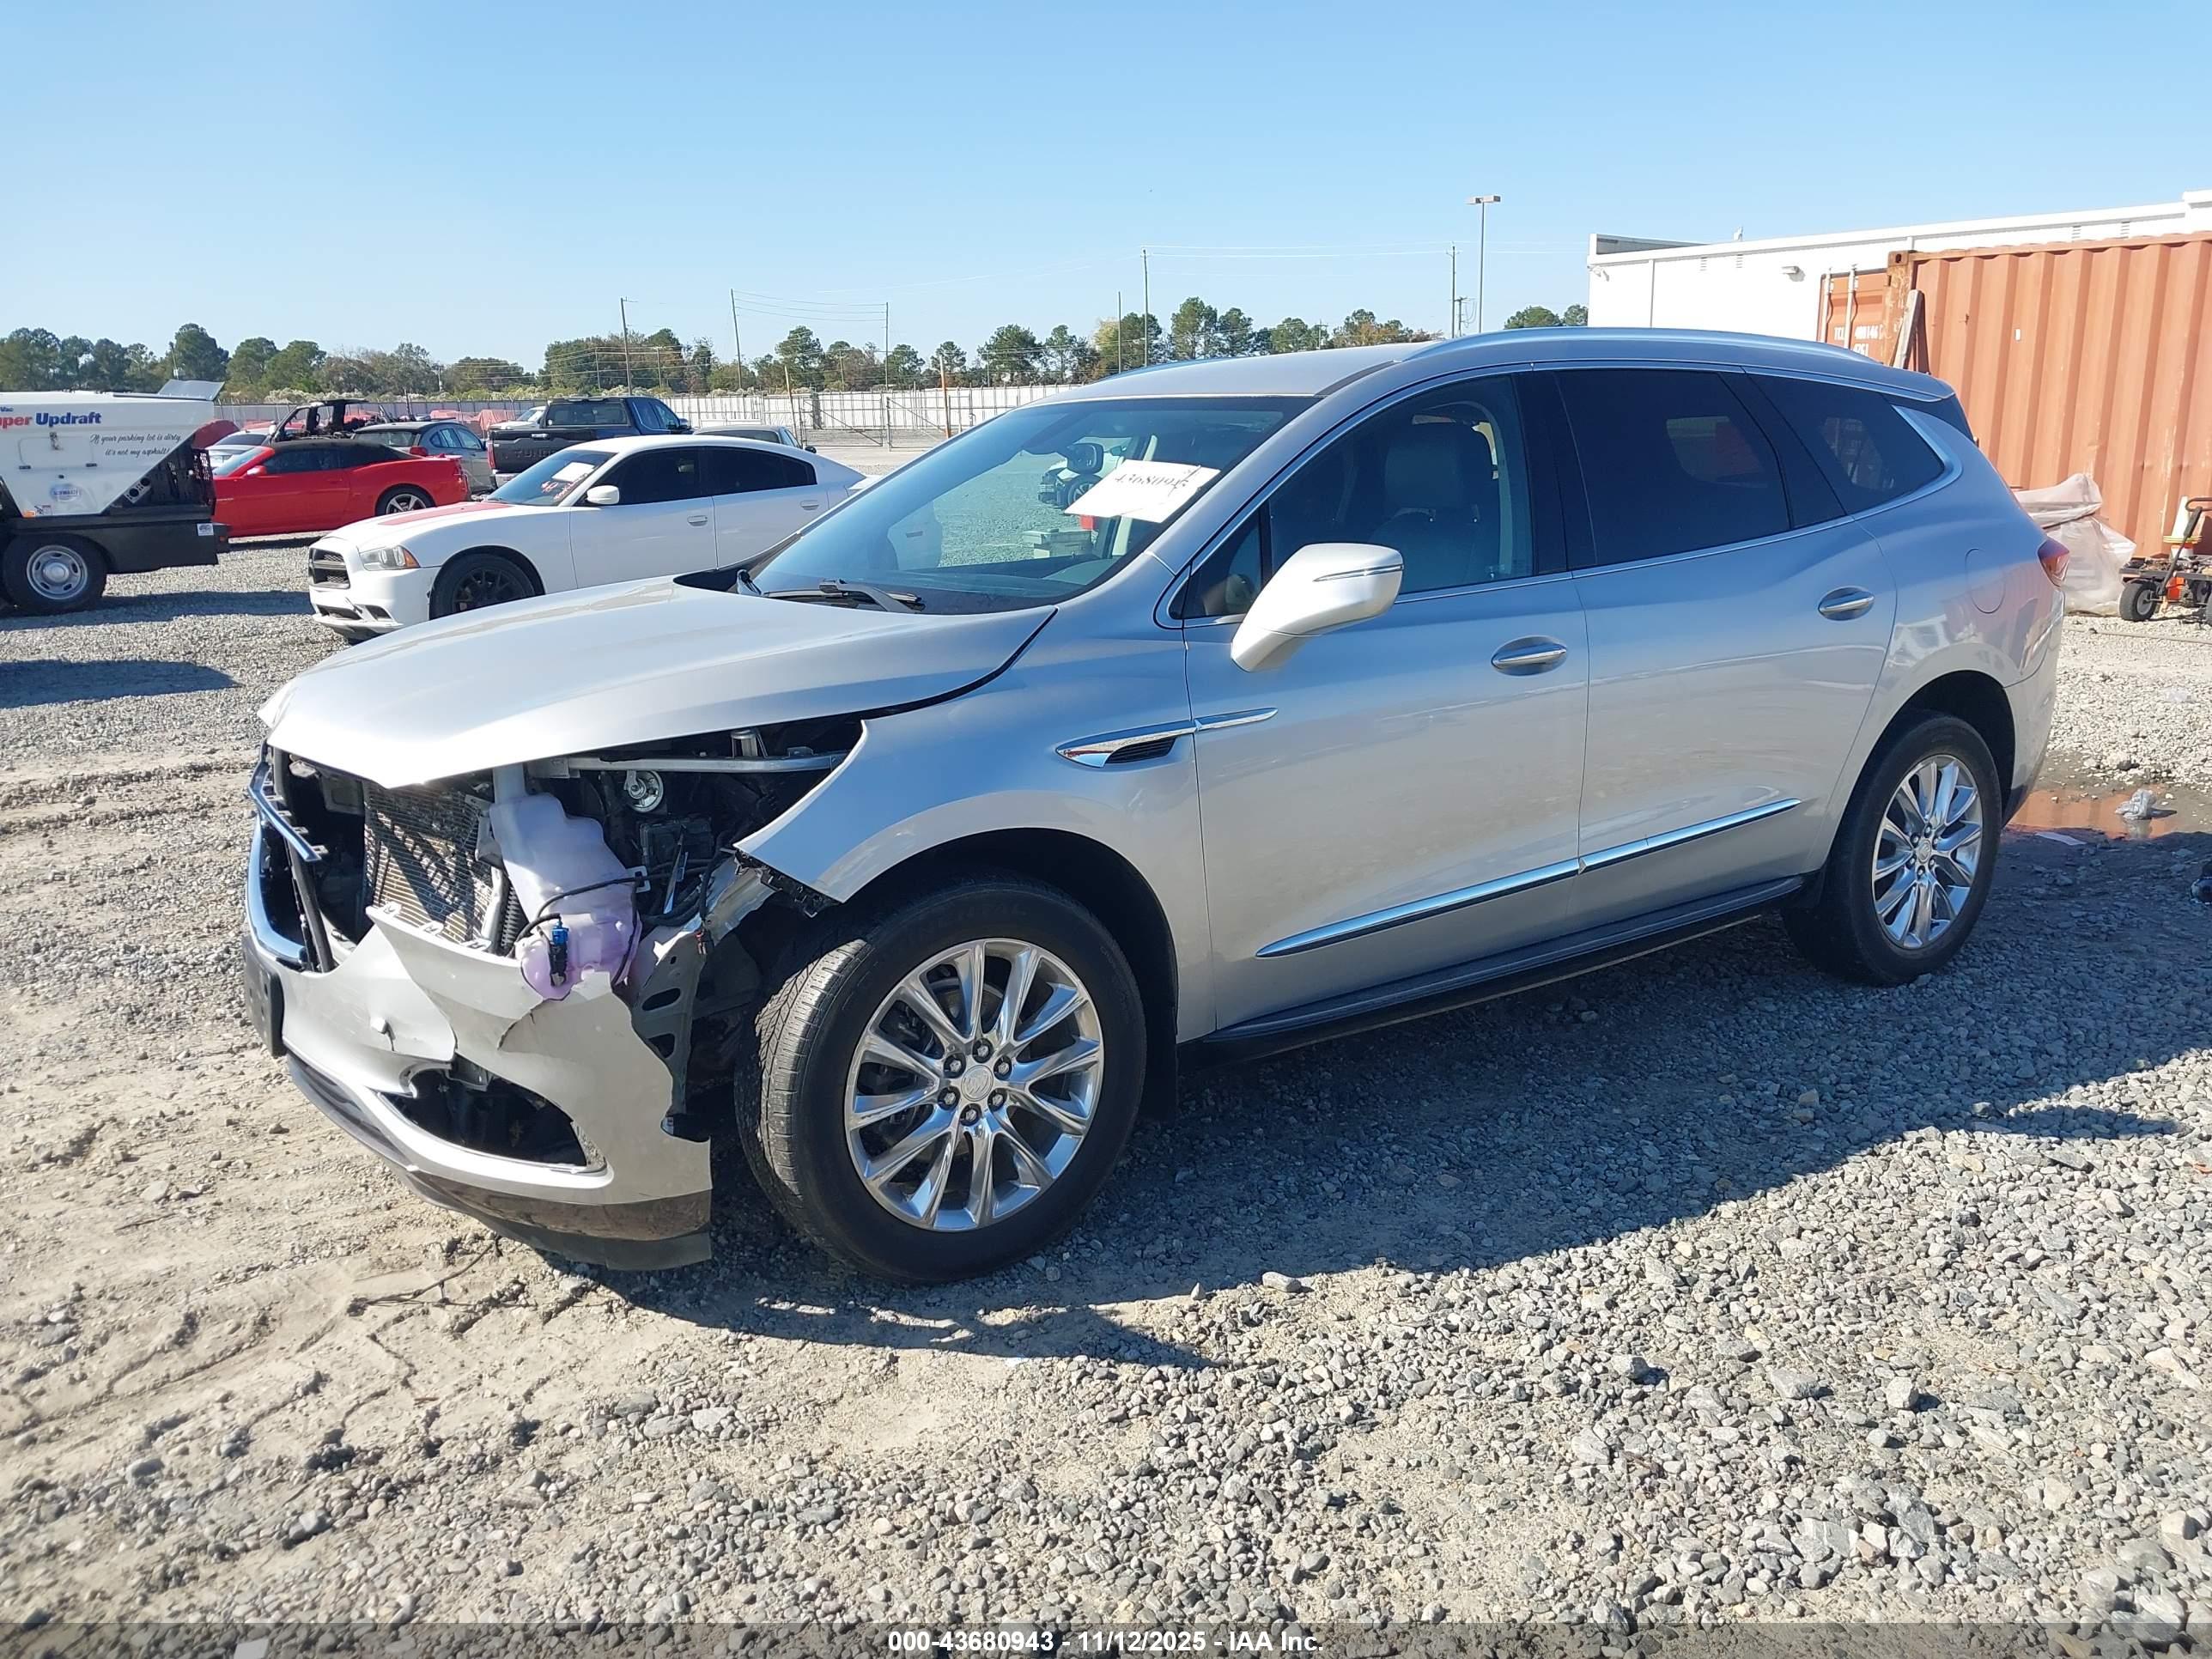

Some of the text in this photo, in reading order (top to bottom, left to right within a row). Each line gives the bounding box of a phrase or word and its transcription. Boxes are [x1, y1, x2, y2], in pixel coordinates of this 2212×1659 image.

[36, 412, 102, 428] Updraft
[101, 435, 117, 445] your
[117, 434, 145, 444] parking
[146, 433, 156, 441] lot
[105, 447, 116, 456] it's
[130, 449, 141, 459] my
